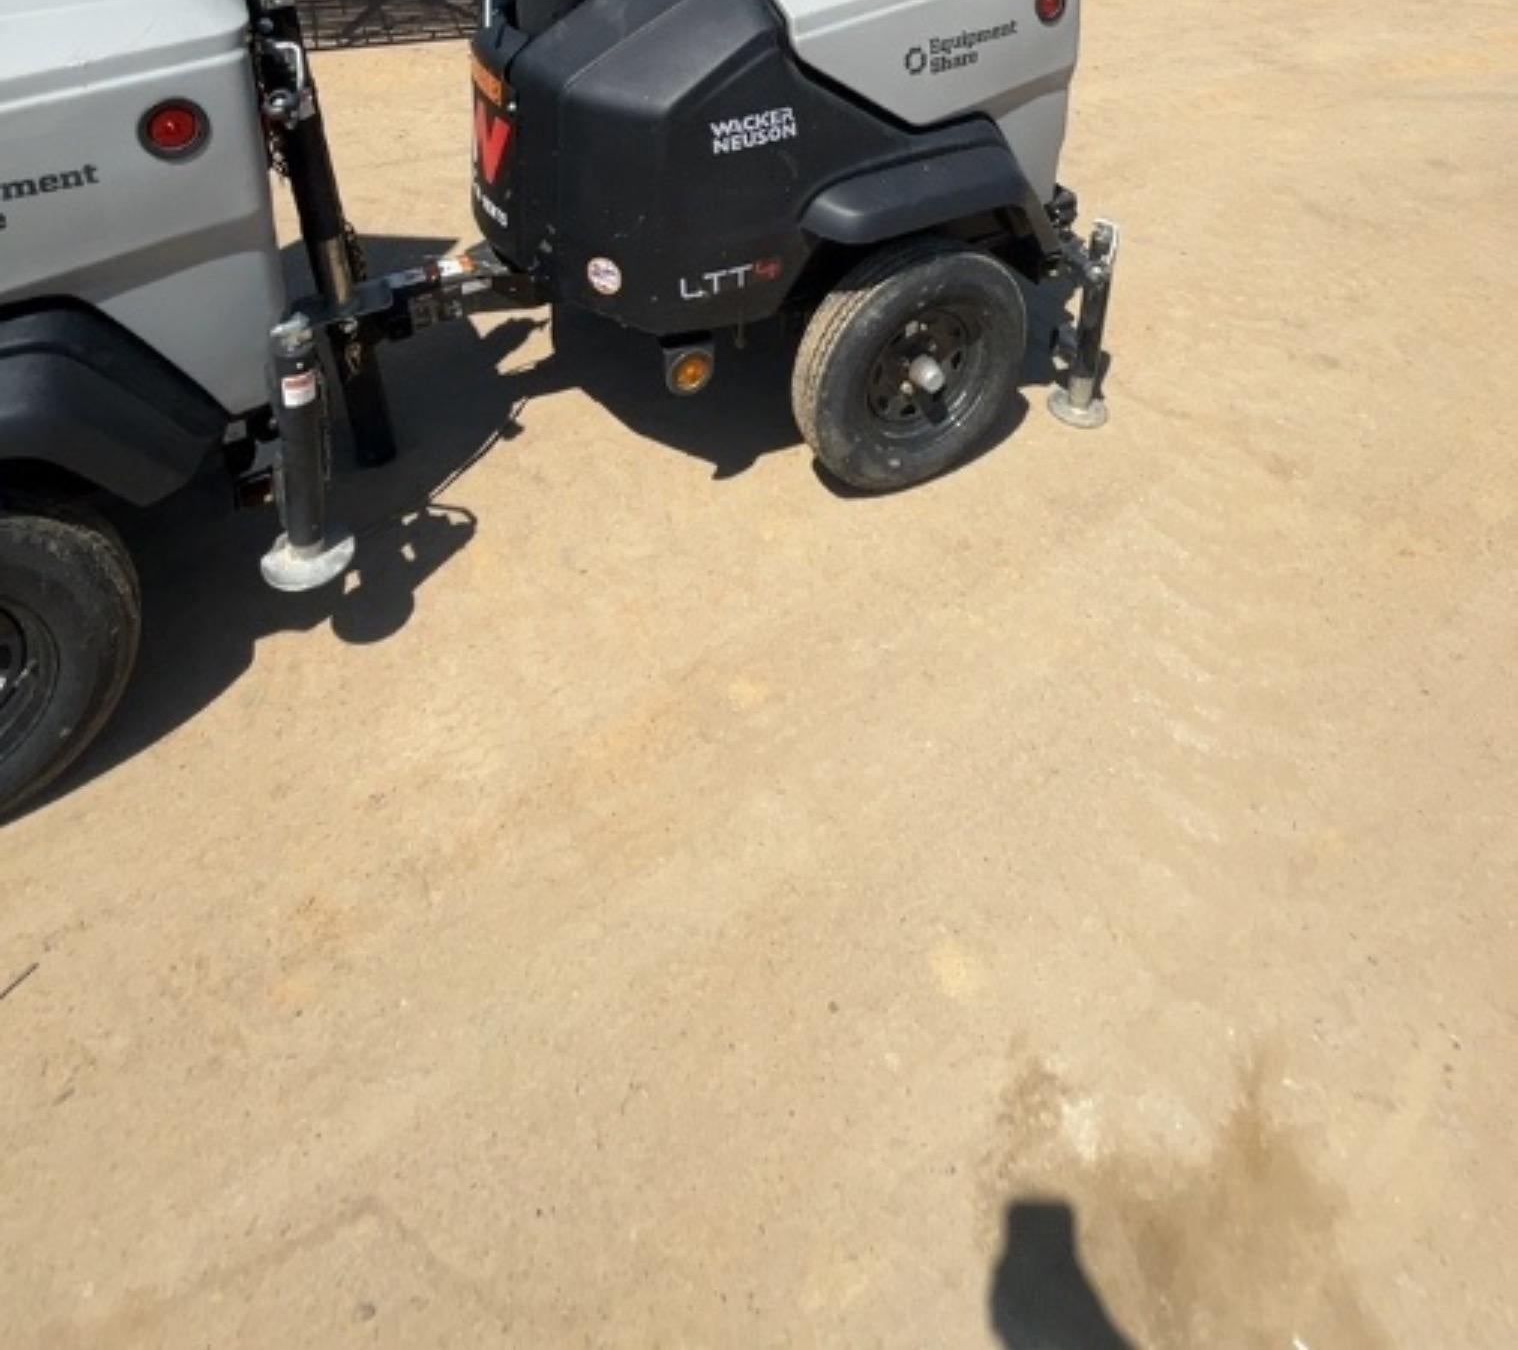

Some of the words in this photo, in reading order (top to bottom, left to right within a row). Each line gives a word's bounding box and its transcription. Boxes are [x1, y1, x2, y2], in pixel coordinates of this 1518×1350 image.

[928, 19, 1018, 54] Equipment
[929, 51, 979, 75] Share
[710, 107, 794, 138] WACKER
[713, 122, 797, 154] NEUSON
